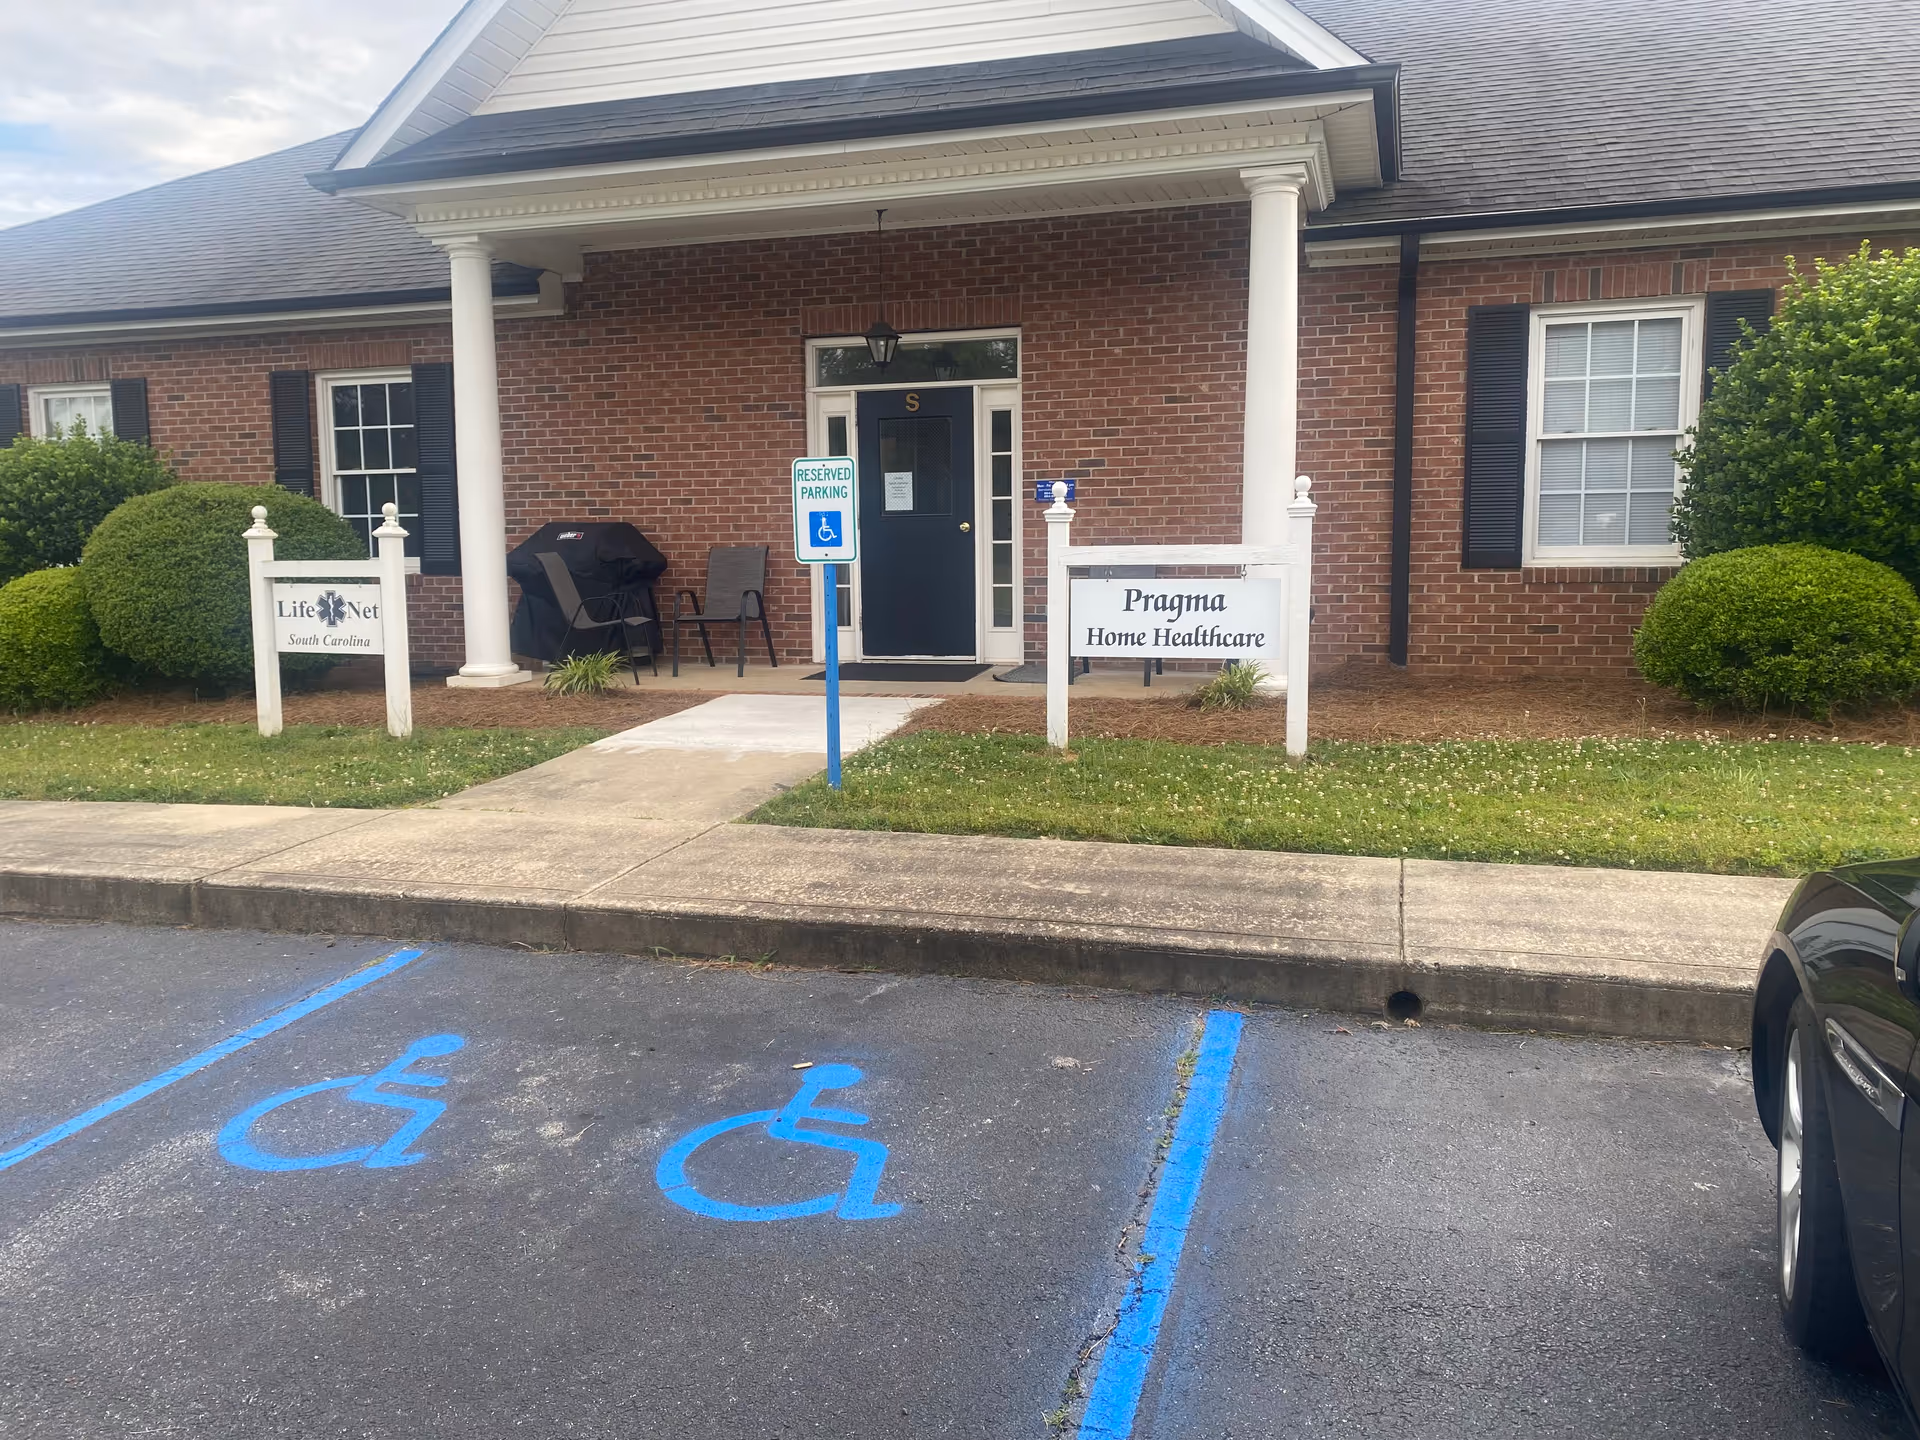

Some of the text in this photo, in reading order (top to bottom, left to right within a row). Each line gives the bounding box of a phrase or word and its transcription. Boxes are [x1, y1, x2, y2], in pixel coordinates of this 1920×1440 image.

[905, 393, 920, 411] S
[797, 468, 850, 481] RESERVED
[801, 486, 848, 499] PARKING
[278, 601, 379, 619] Life Net
[1122, 588, 1228, 623] Pragma
[288, 633, 370, 647] South Carolina
[1085, 625, 1266, 648] Home Healthcare
